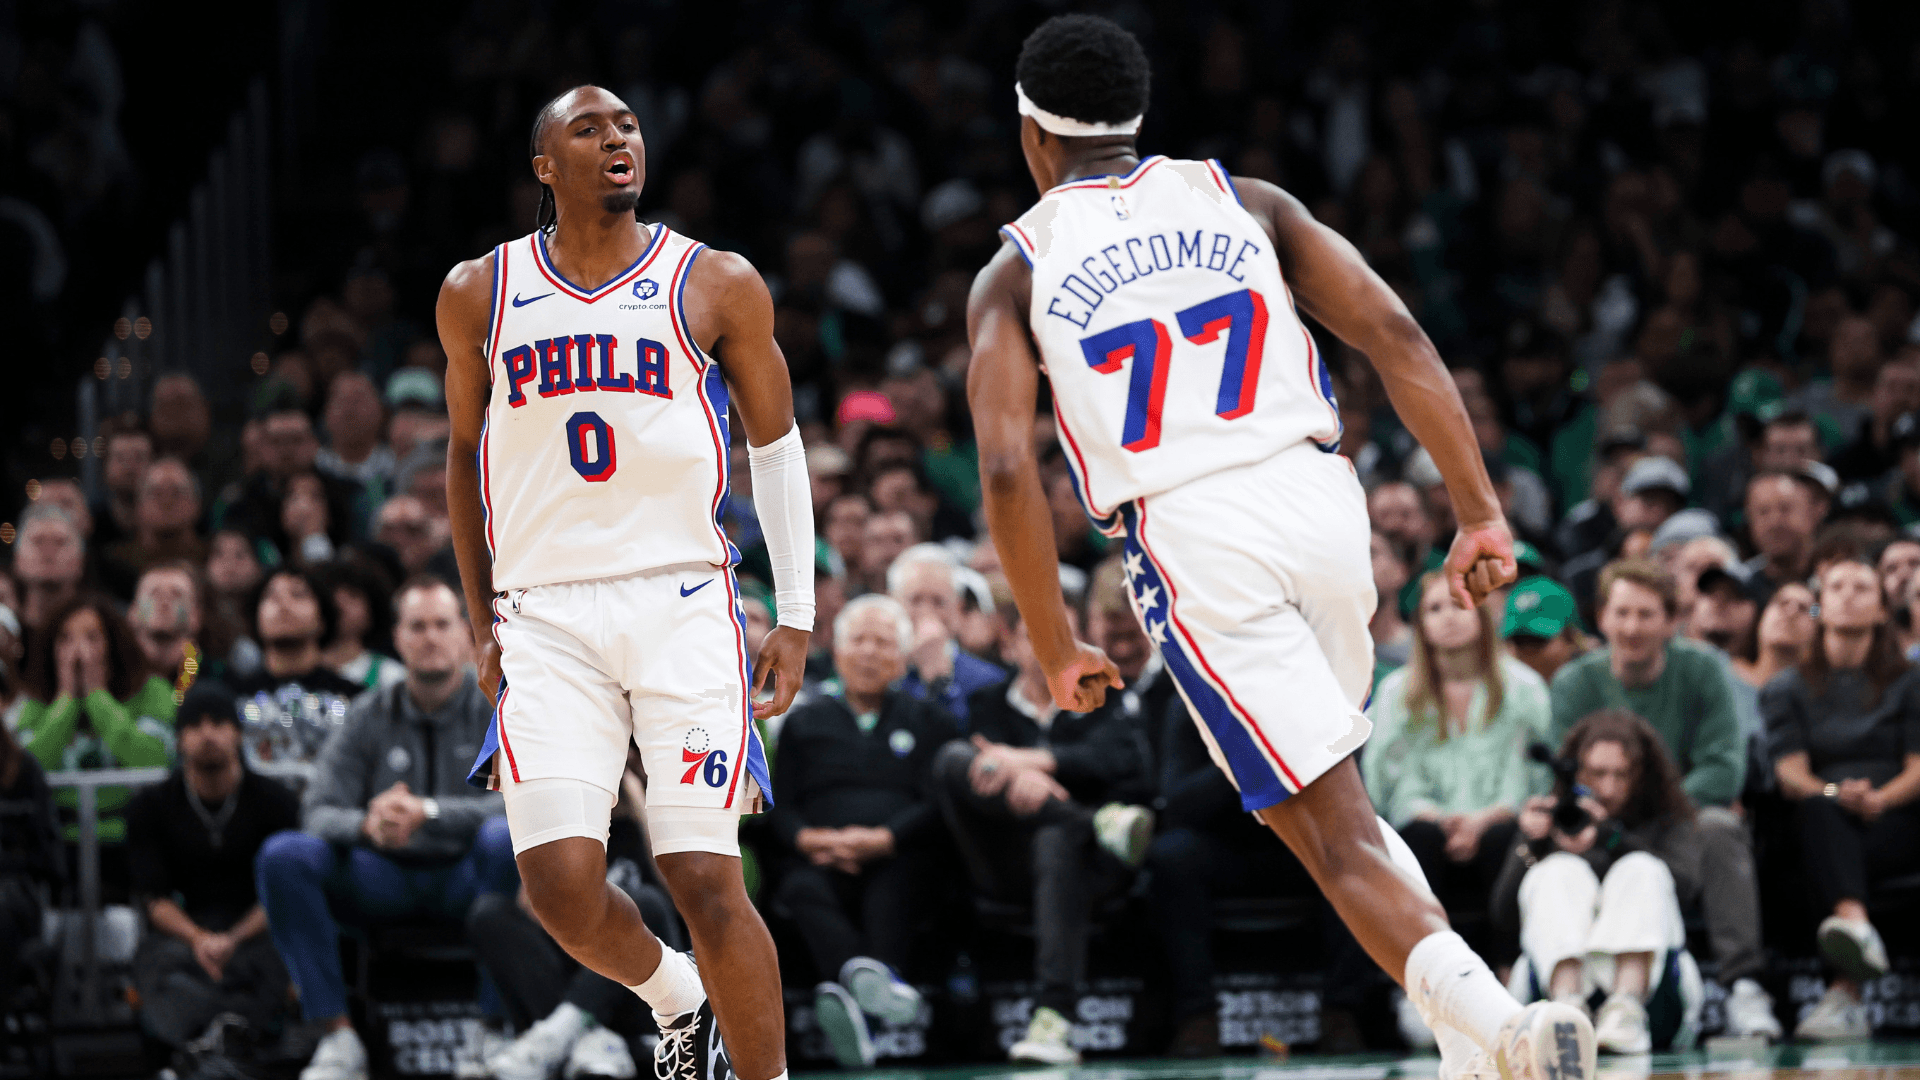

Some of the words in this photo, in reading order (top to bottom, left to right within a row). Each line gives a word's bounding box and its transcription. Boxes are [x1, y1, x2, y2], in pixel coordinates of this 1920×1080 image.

[1047, 230, 1260, 330] EDGECOMBE
[502, 333, 673, 408] PHILA
[1079, 288, 1270, 453] 77
[566, 411, 617, 482] 0
[680, 746, 728, 788] 76
